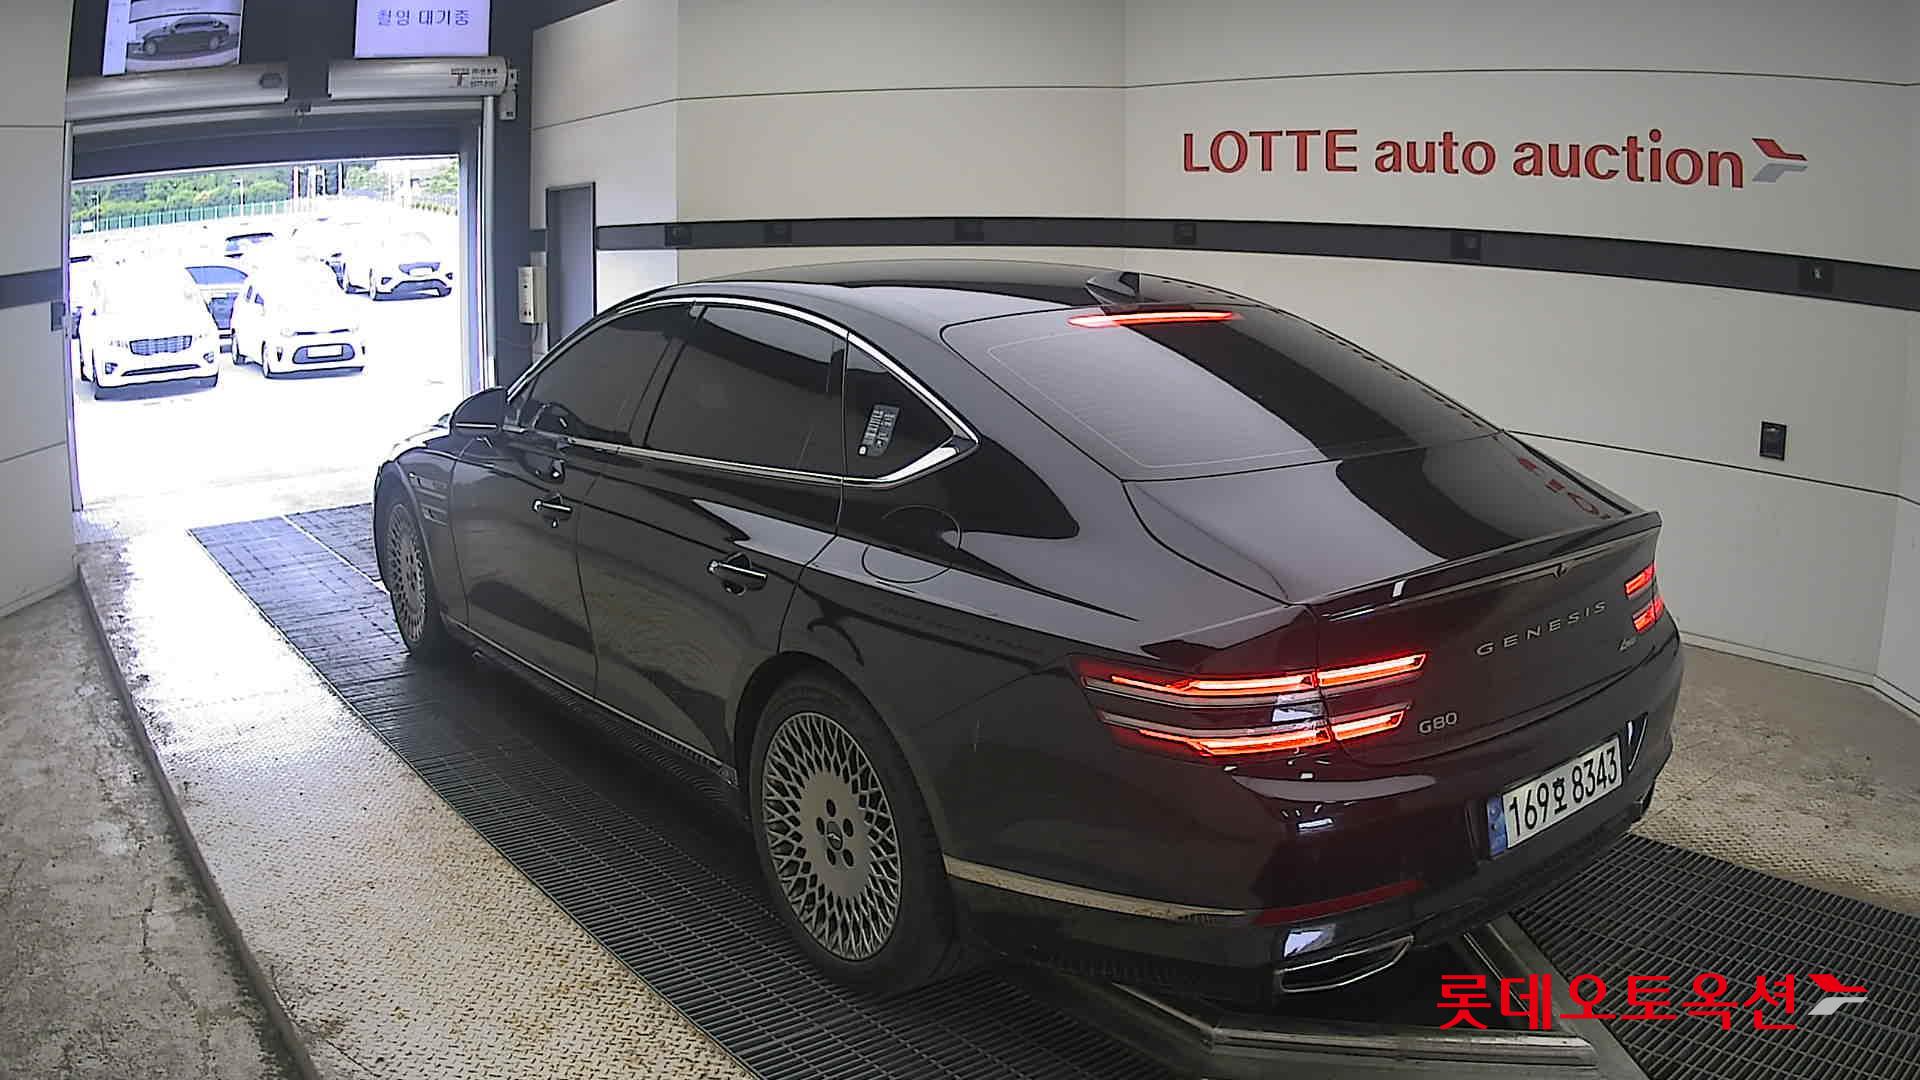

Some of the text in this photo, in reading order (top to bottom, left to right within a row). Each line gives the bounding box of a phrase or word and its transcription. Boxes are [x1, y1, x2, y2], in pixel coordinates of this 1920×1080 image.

[418, 9, 470, 26] 대기중
[1183, 128, 1744, 189] LOTTE auto auction
[1475, 600, 1607, 656] GENESIS
[1418, 711, 1458, 735] G80
[1508, 746, 1618, 837] 169호 8343
